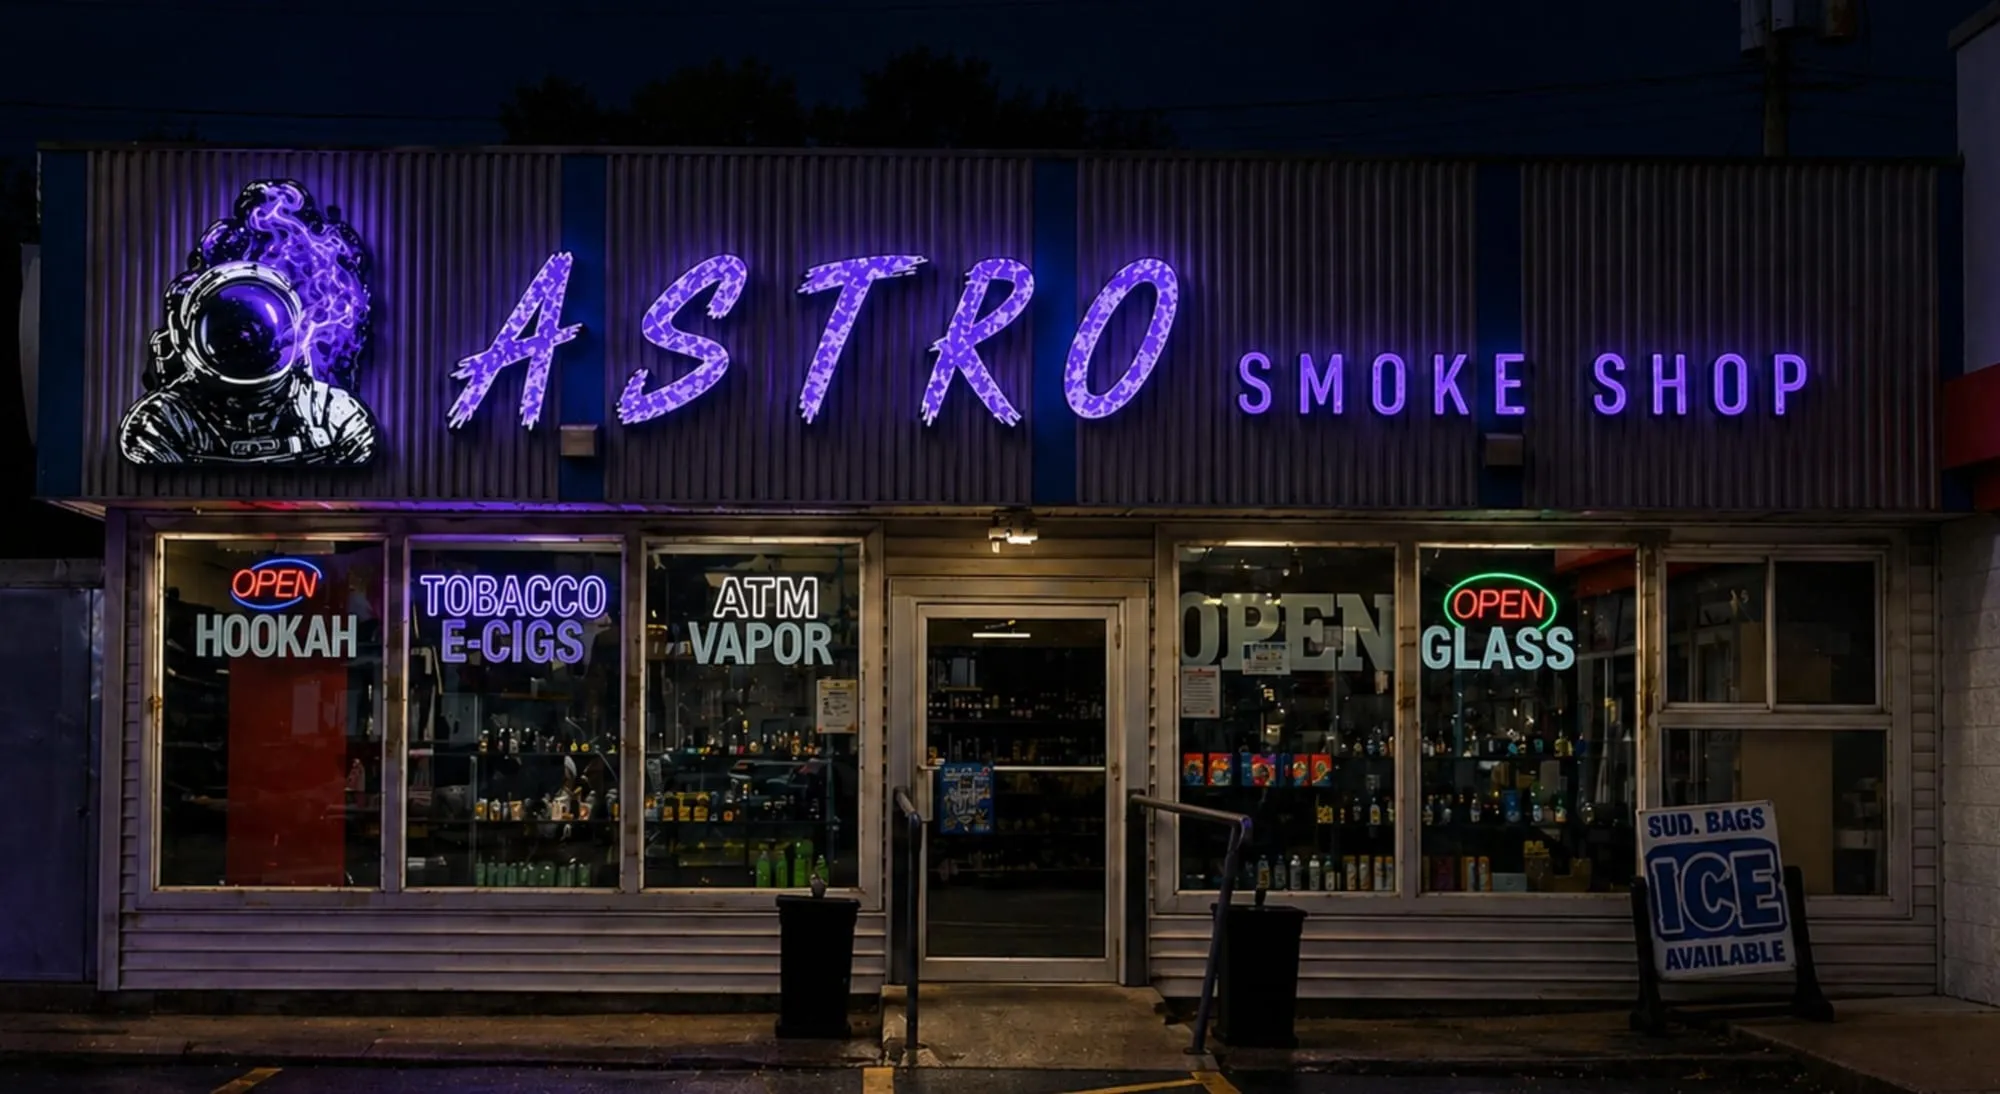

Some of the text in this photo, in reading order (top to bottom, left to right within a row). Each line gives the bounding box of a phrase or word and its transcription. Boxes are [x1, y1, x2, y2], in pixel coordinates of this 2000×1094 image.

[448, 250, 1809, 431] ASTRO SMOKE SHOP
[232, 569, 317, 599] OPEN
[419, 574, 607, 619] TOBACCO
[713, 576, 818, 619] ATM
[1453, 588, 1545, 620] OPEN
[196, 613, 357, 659] HOOKAH
[441, 619, 584, 664] E-CIGS
[688, 621, 833, 666] VAPOR
[1180, 591, 1394, 672] OPEN
[1422, 625, 1575, 670] GLASS
[1705, 807, 1765, 833] BAGS
[1651, 850, 1784, 934] ICE
[1665, 940, 1786, 970] AVAILABLE
